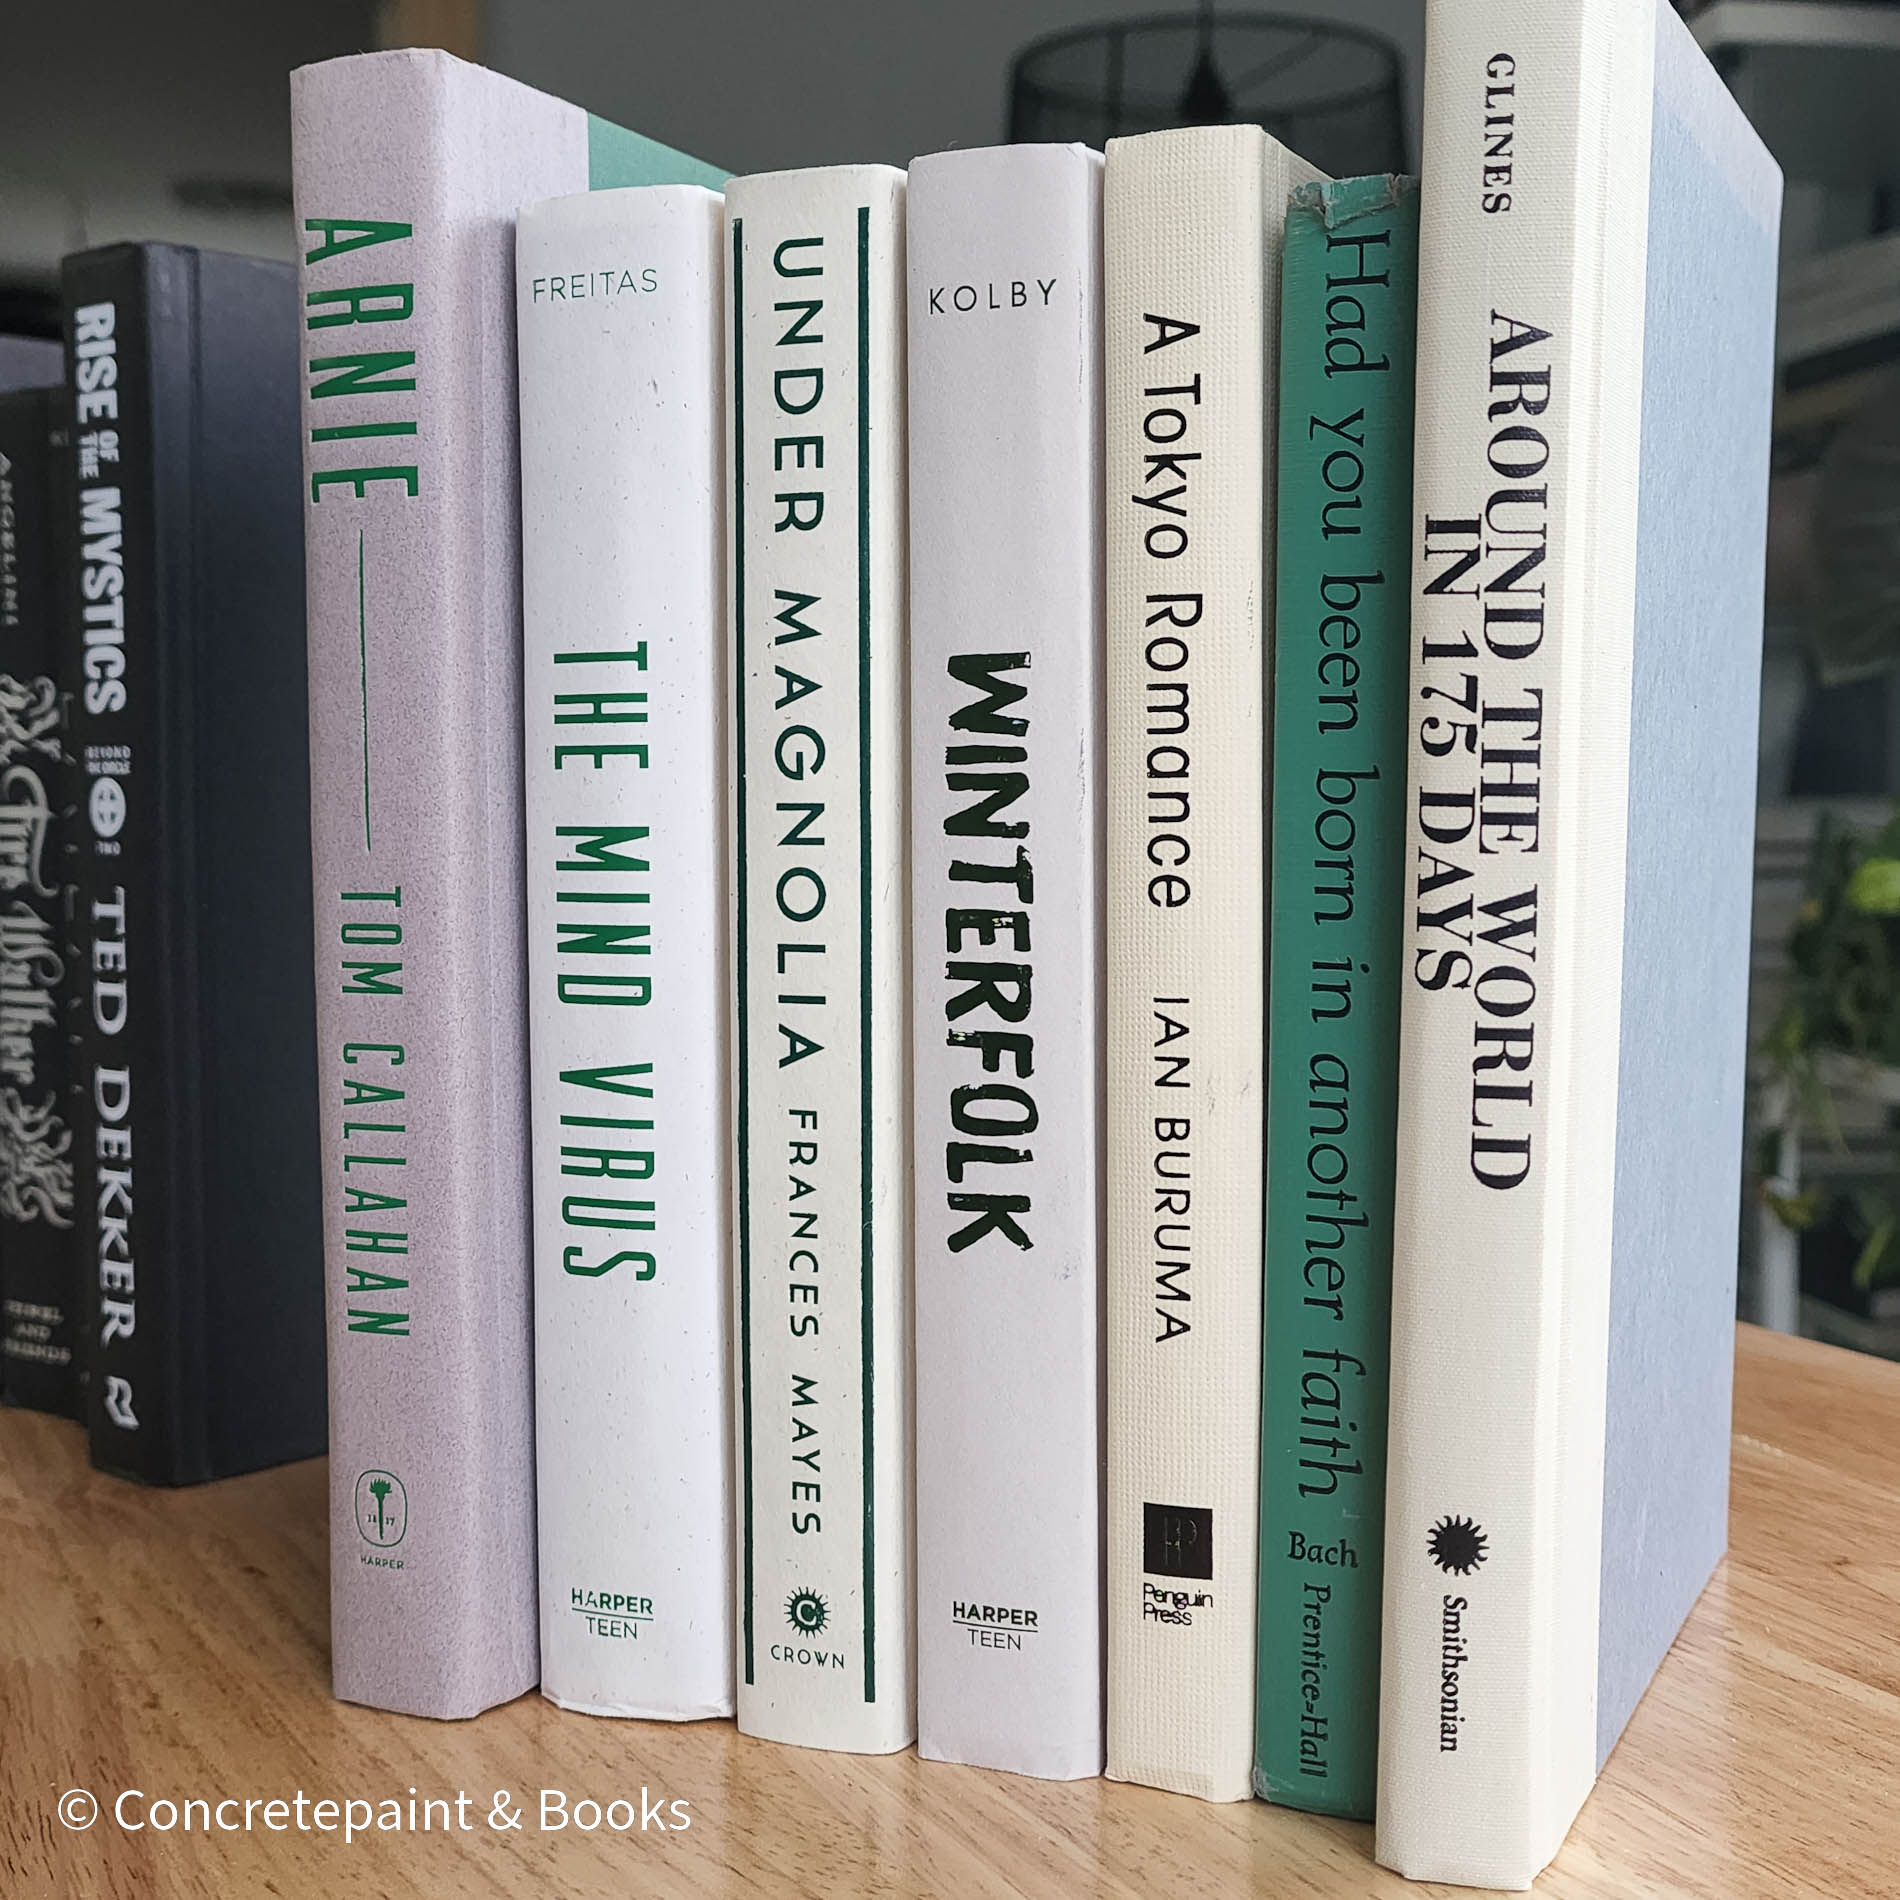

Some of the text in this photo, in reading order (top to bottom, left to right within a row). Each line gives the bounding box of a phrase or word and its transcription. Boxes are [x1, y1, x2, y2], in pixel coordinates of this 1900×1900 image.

[1481, 52, 1516, 214] GLINES
[305, 218, 419, 503] ARNIE
[532, 268, 658, 304] FREITAS
[929, 278, 1057, 315] KOLBY
[75, 302, 127, 714] RISE OF THE MYSTICS
[1131, 312, 1204, 908] A Tokyo Romance
[773, 236, 827, 1069] UNDER MAGNOLIA
[1415, 514, 1482, 992] IN 175 DAYS
[1470, 308, 1554, 1191] AROUND THE WORLD
[553, 640, 657, 1282] THE MIND VIRUS
[942, 651, 1040, 1254] WINTERFOLK
[1299, 229, 1391, 1498] Had you been born in another faith
[92, 886, 136, 1344] TED DEKKER
[340, 885, 410, 1337] TOM CALLAHAN
[1153, 997, 1191, 1344] IAN BURUMA
[788, 1108, 821, 1535] FRANCES MAYES
[360, 1554, 404, 1570] HARPER
[571, 1588, 654, 1615] HARPER
[585, 1616, 638, 1639] TEEN
[770, 1644, 845, 1669] CROWN
[952, 1601, 1038, 1626] HARPER
[966, 1628, 1022, 1651] TEEN
[1143, 1582, 1214, 1610] Penguin
[1143, 1602, 1193, 1626] Press
[1287, 1530, 1361, 1569] Bach
[1439, 1594, 1469, 1753] Smithsonian
